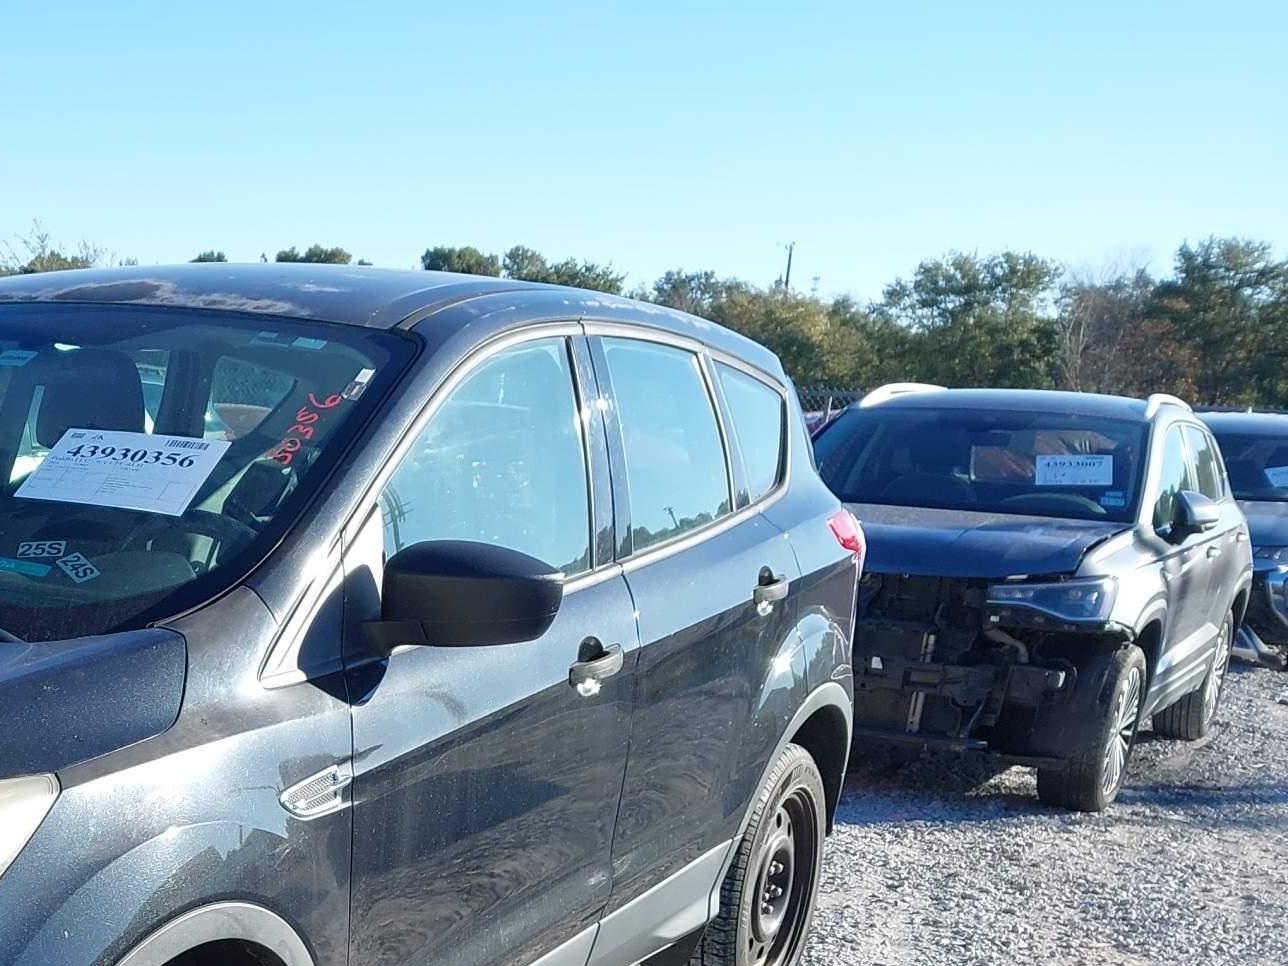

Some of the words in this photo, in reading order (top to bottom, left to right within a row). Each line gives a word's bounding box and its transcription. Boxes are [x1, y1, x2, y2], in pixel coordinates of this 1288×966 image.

[66, 444, 200, 469] 43930356
[19, 542, 63, 556] 25S
[61, 555, 95, 578] 24S
